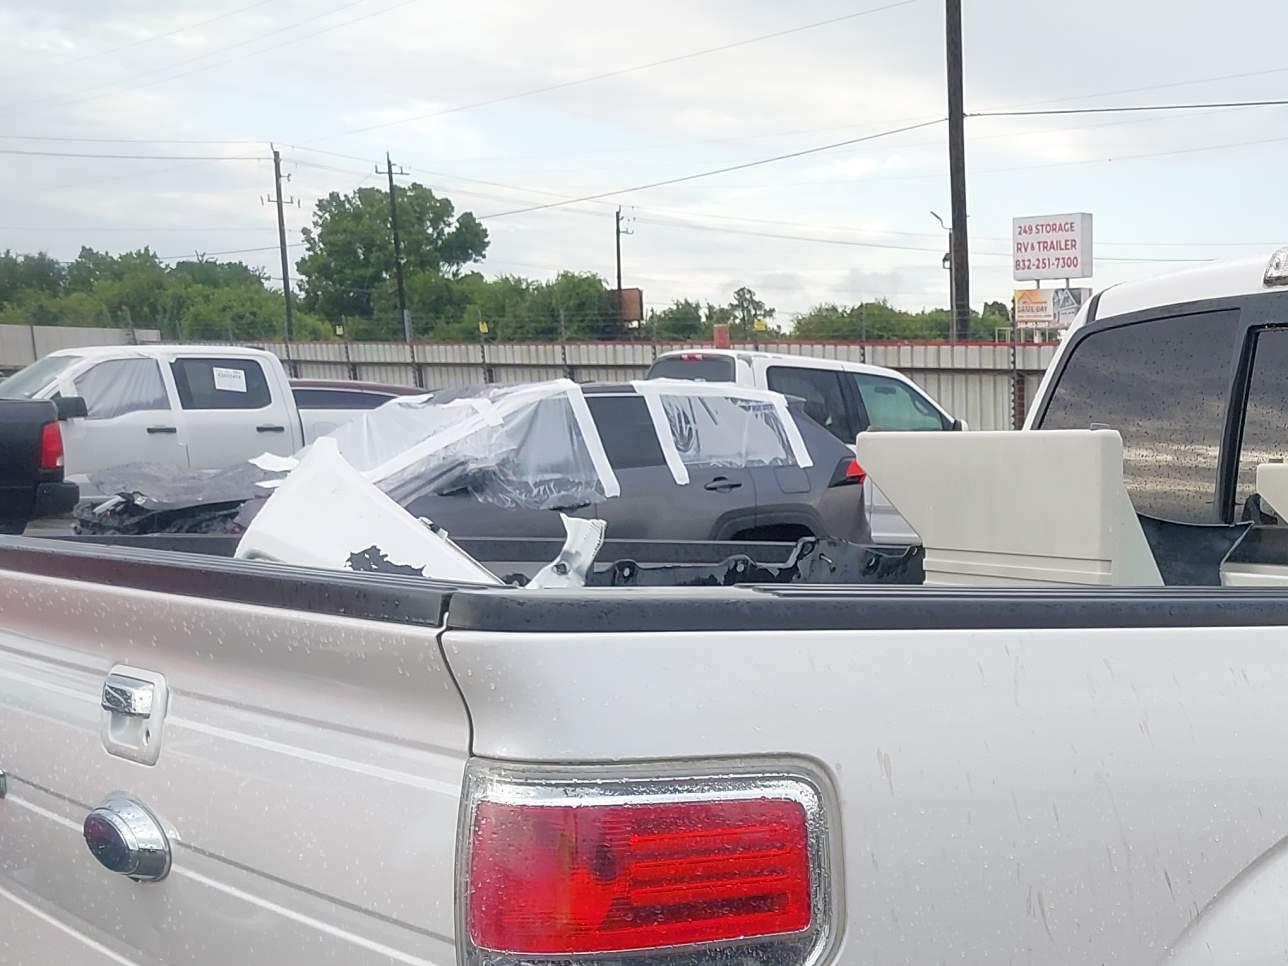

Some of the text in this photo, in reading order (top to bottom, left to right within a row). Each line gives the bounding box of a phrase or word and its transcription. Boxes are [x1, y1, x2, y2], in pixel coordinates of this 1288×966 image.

[1017, 222, 1075, 235] 249 STORAGE
[1016, 242, 1030, 253] RV
[1037, 239, 1077, 252] TRAILER
[1015, 257, 1079, 271] 832-251-7300
